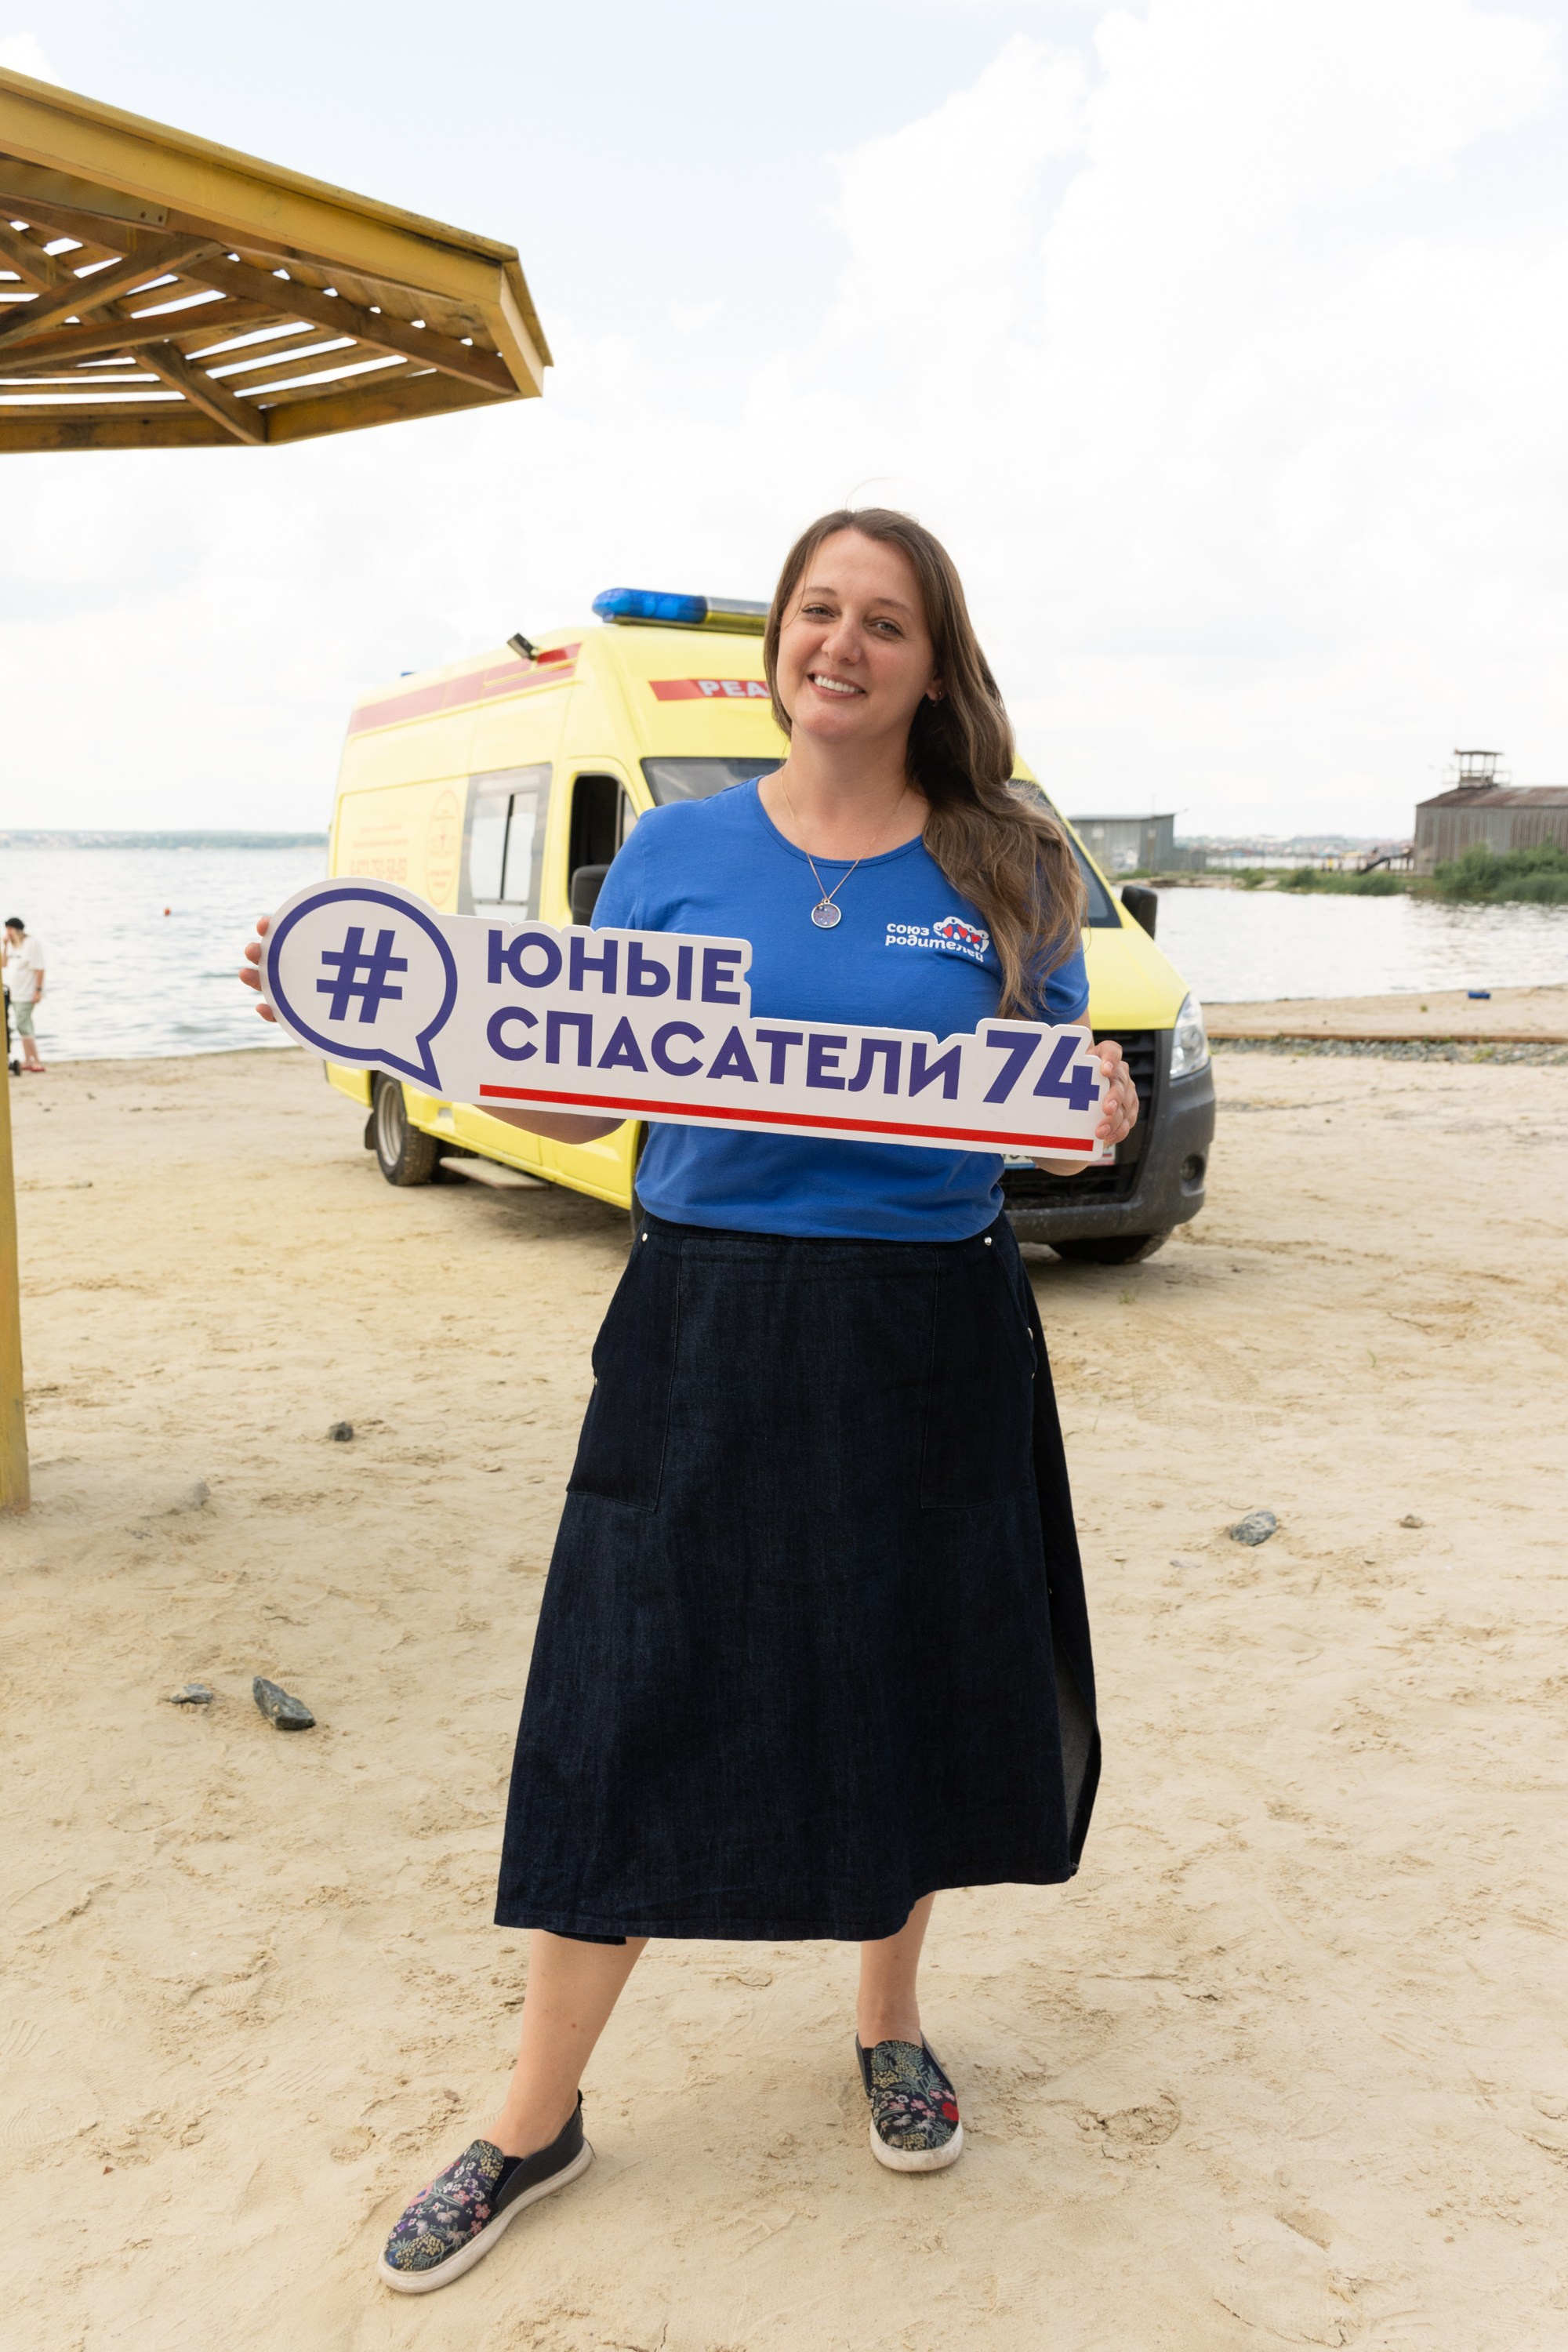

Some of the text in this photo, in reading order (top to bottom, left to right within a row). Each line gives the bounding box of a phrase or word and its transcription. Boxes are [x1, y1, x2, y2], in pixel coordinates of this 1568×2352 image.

[697, 680, 772, 698] РЕА
[885, 935, 984, 963] родителей
[886, 923, 930, 937] союз
[317, 927, 408, 1023] #
[488, 930, 742, 1005] ЮНЫЕ
[487, 1006, 1101, 1112] СПАСАТЕЛИ 74
